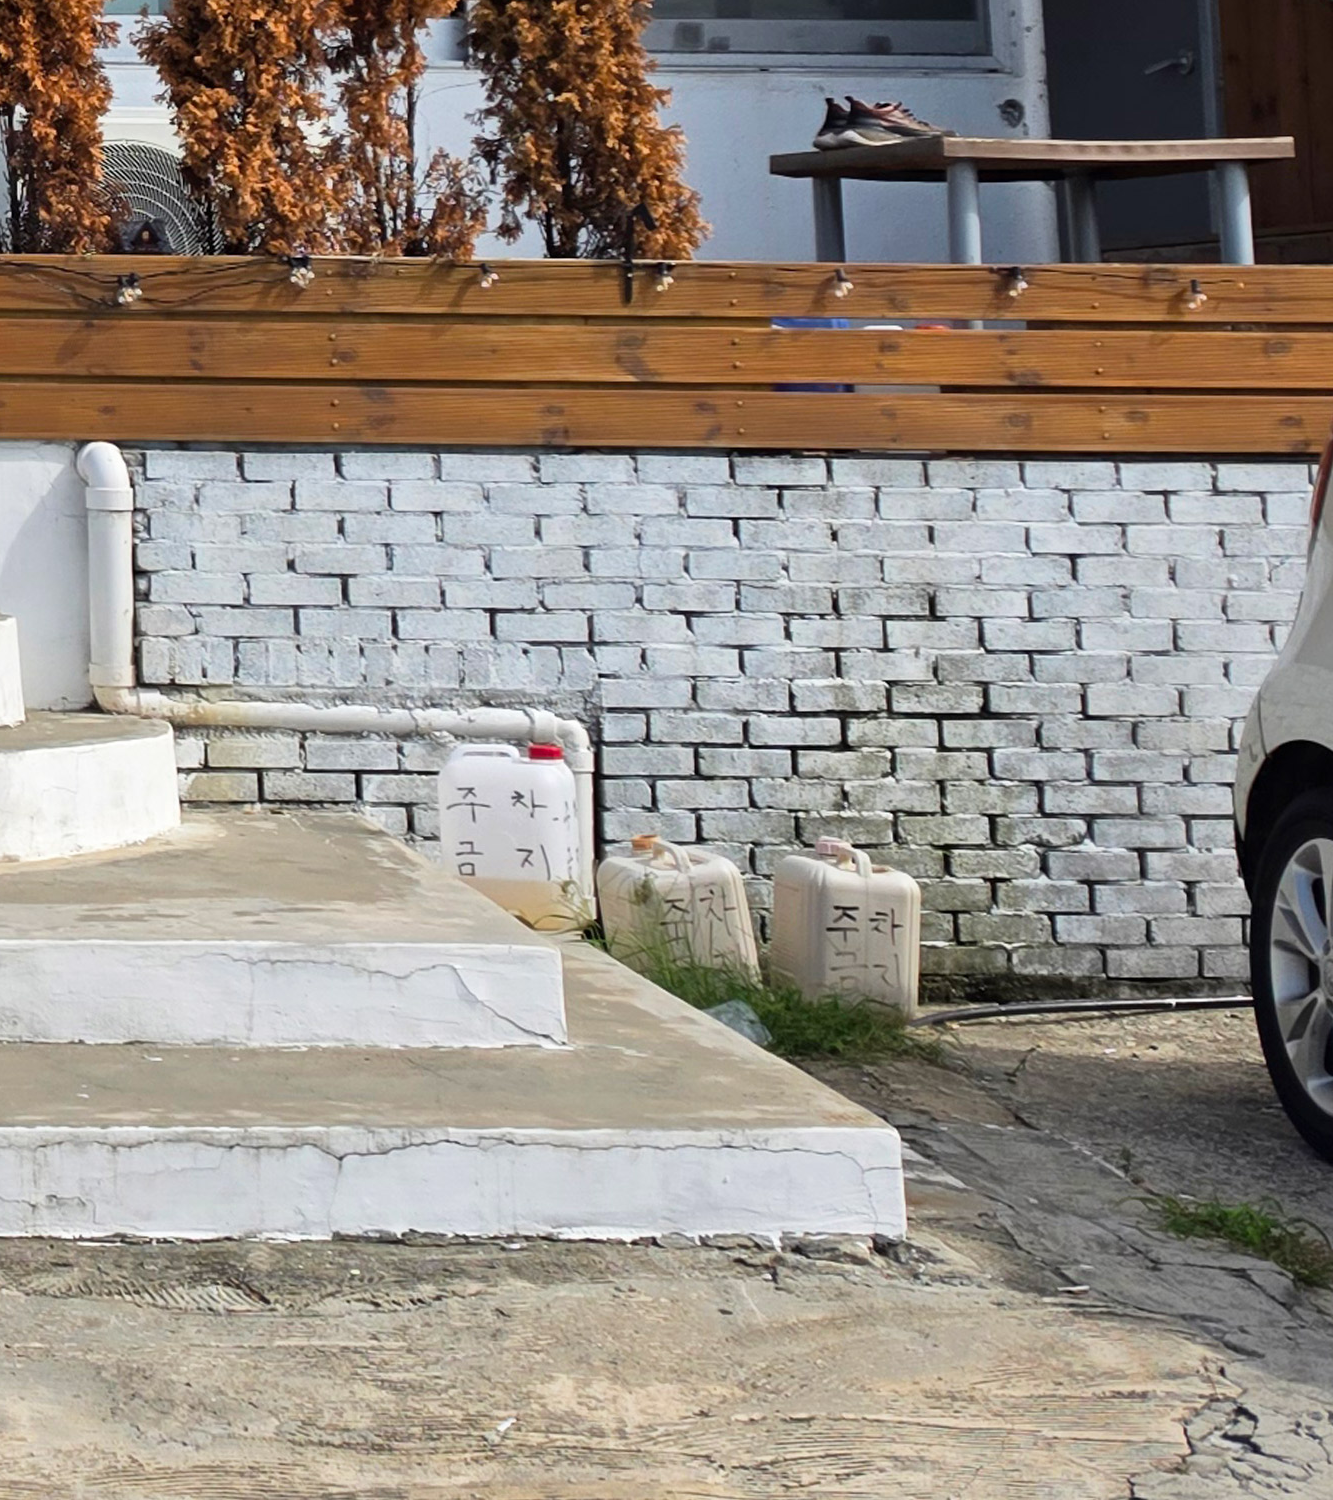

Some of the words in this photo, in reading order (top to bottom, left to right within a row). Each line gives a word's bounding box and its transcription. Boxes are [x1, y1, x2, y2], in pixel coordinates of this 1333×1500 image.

[660, 887, 737, 945] 주차
[826, 905, 904, 946] 주차
[830, 952, 901, 992] 금지
